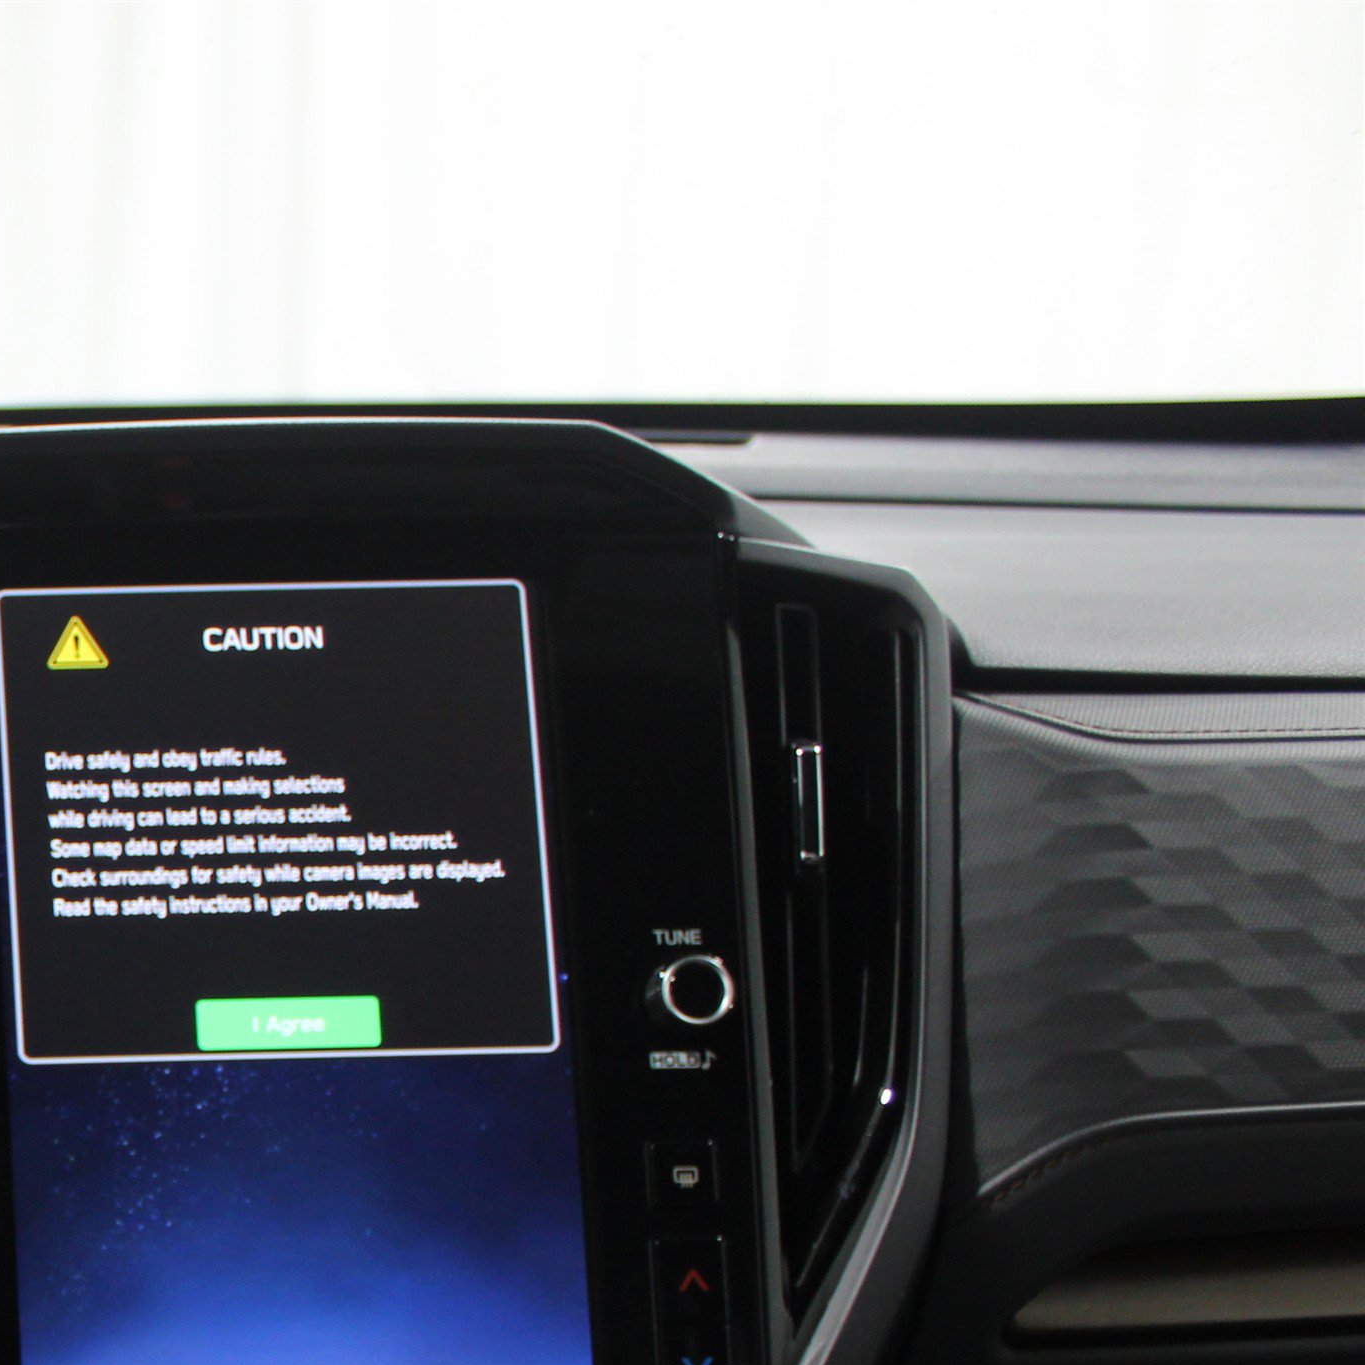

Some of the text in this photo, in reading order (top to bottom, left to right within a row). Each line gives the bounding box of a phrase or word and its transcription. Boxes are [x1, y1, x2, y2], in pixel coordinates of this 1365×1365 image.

[202, 625, 324, 653] CAUTION
[44, 747, 287, 773] Drive safely and obey traffic rules.
[46, 775, 345, 803] Watching this screen and making selections
[48, 803, 352, 831] while driving can lead to a serious accident.
[50, 830, 458, 860] Some map data or speed limit information may be incorrect.
[51, 858, 506, 889] Check surroundings for safety while camera images are displayed.
[53, 890, 420, 919] Read the safety instructions in your Owner's Manual.
[652, 928, 702, 946] TUNE
[252, 1015, 327, 1036] I Agree
[649, 1051, 701, 1069] HOLD
